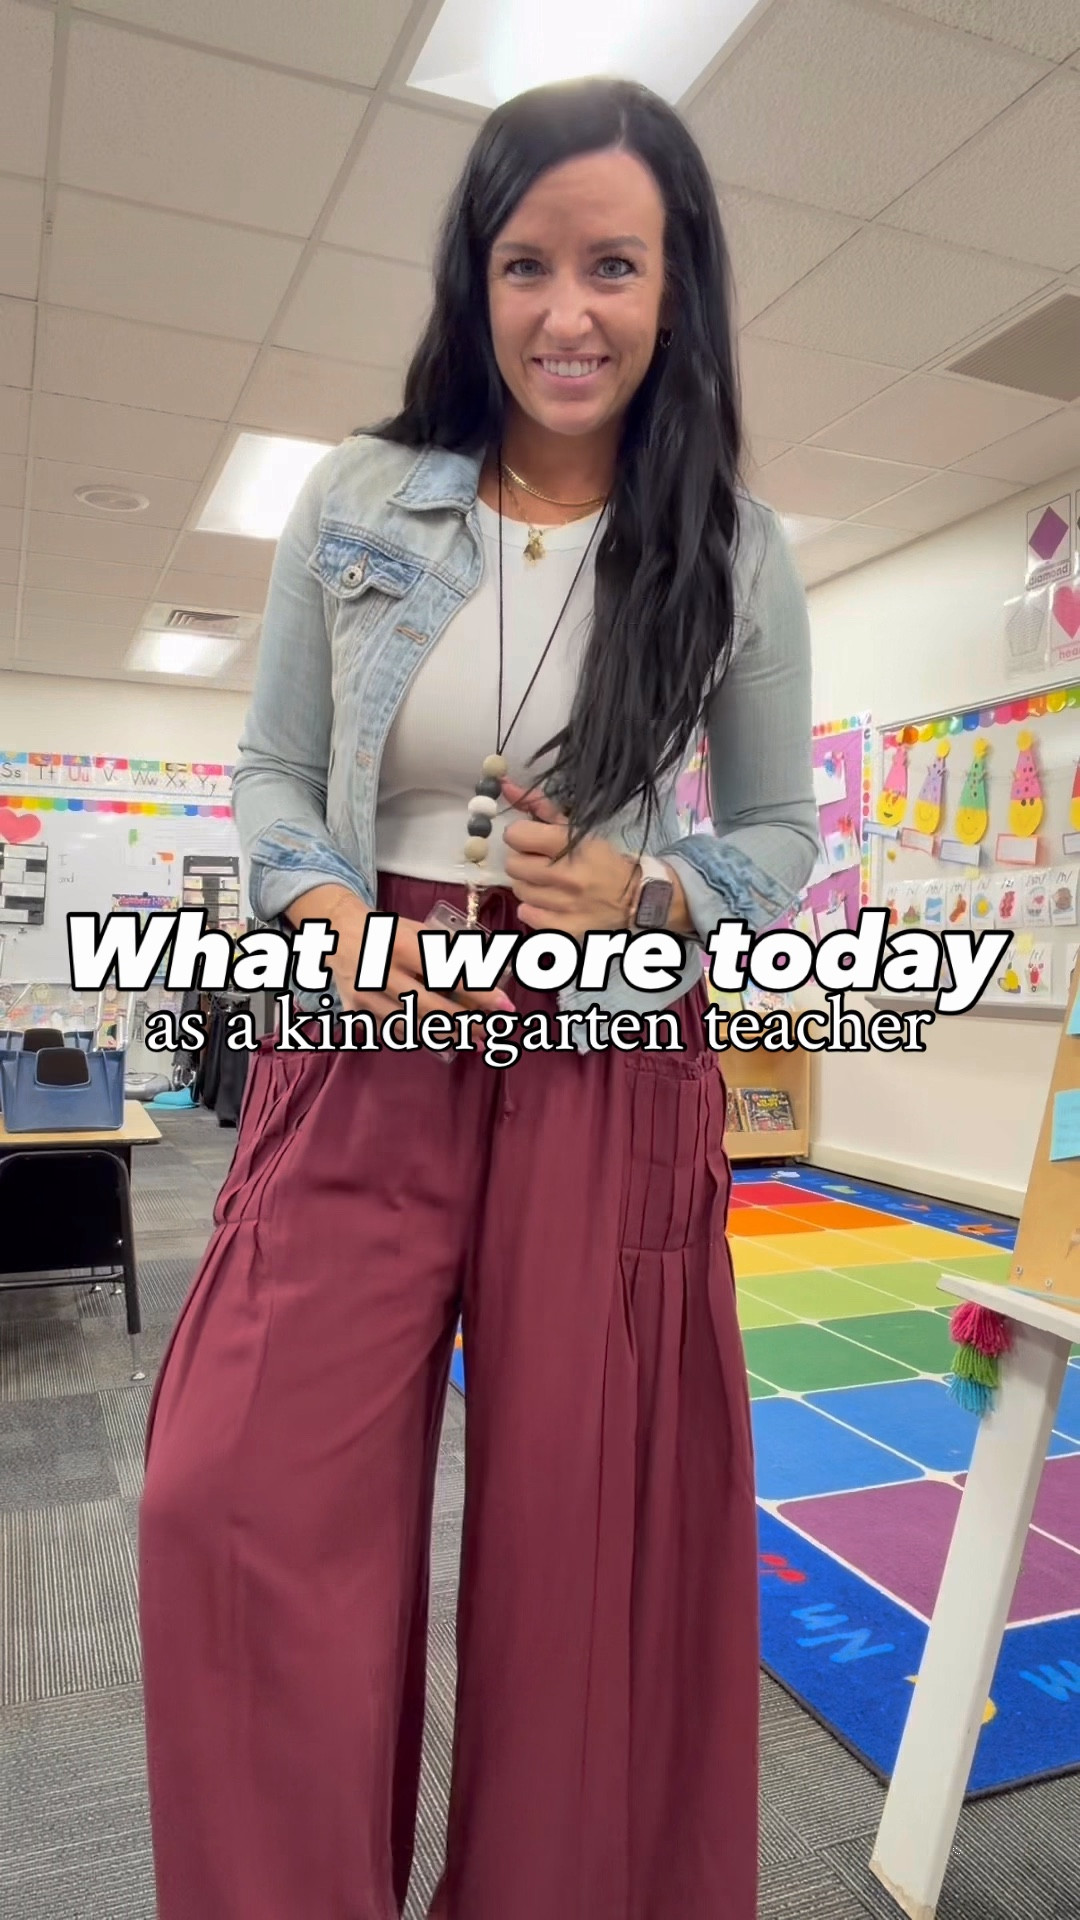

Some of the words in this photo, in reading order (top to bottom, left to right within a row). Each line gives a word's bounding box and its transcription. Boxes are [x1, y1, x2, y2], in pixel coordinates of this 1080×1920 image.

[1029, 563, 1068, 585] diamond
[1058, 646, 1080, 660] hea
[1, 762, 21, 779] Ss
[69, 765, 90, 782] Uu
[131, 770, 158, 786] Ww
[166, 772, 187, 788] Xx
[197, 774, 217, 797] Yy
